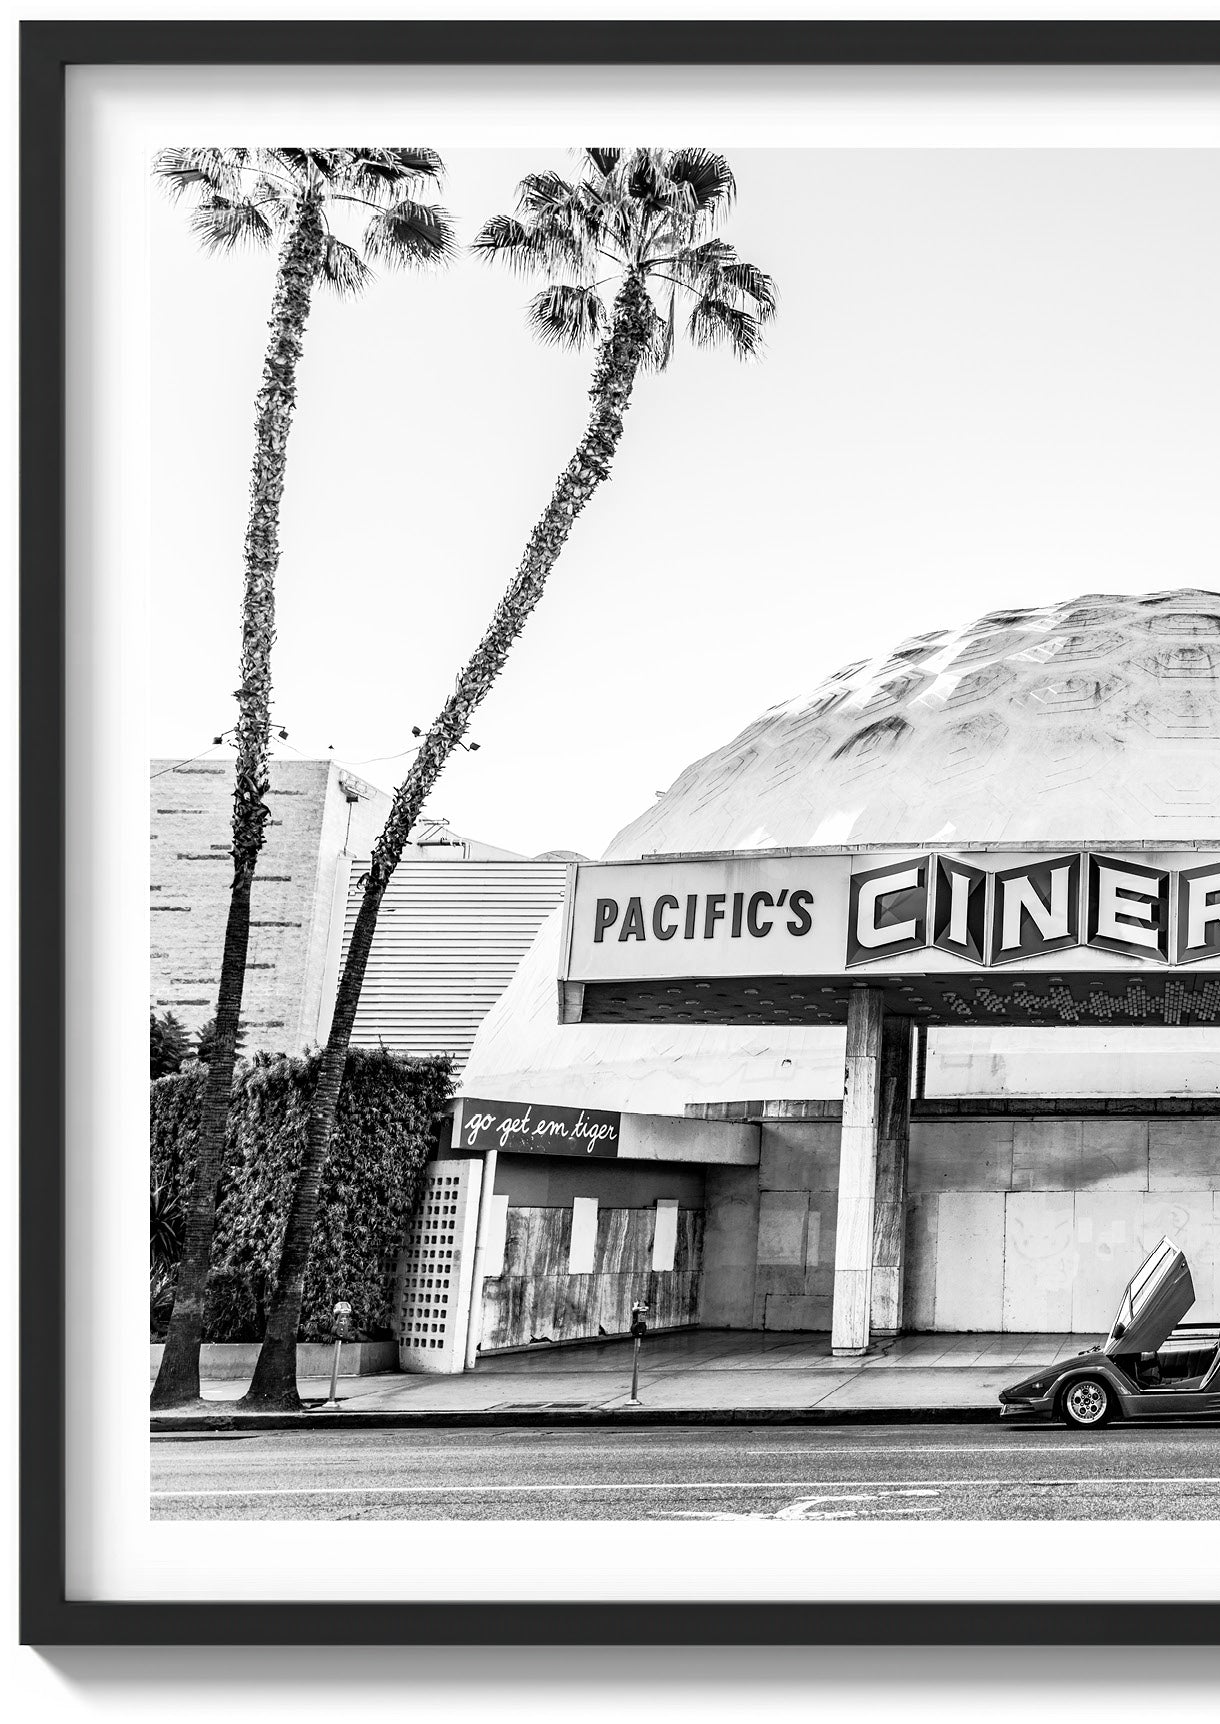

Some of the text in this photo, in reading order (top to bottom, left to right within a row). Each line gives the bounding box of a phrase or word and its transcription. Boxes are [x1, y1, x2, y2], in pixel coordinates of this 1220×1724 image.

[593, 889, 815, 943] PACIFIC'S
[464, 1105, 618, 1153] go get em tiger
